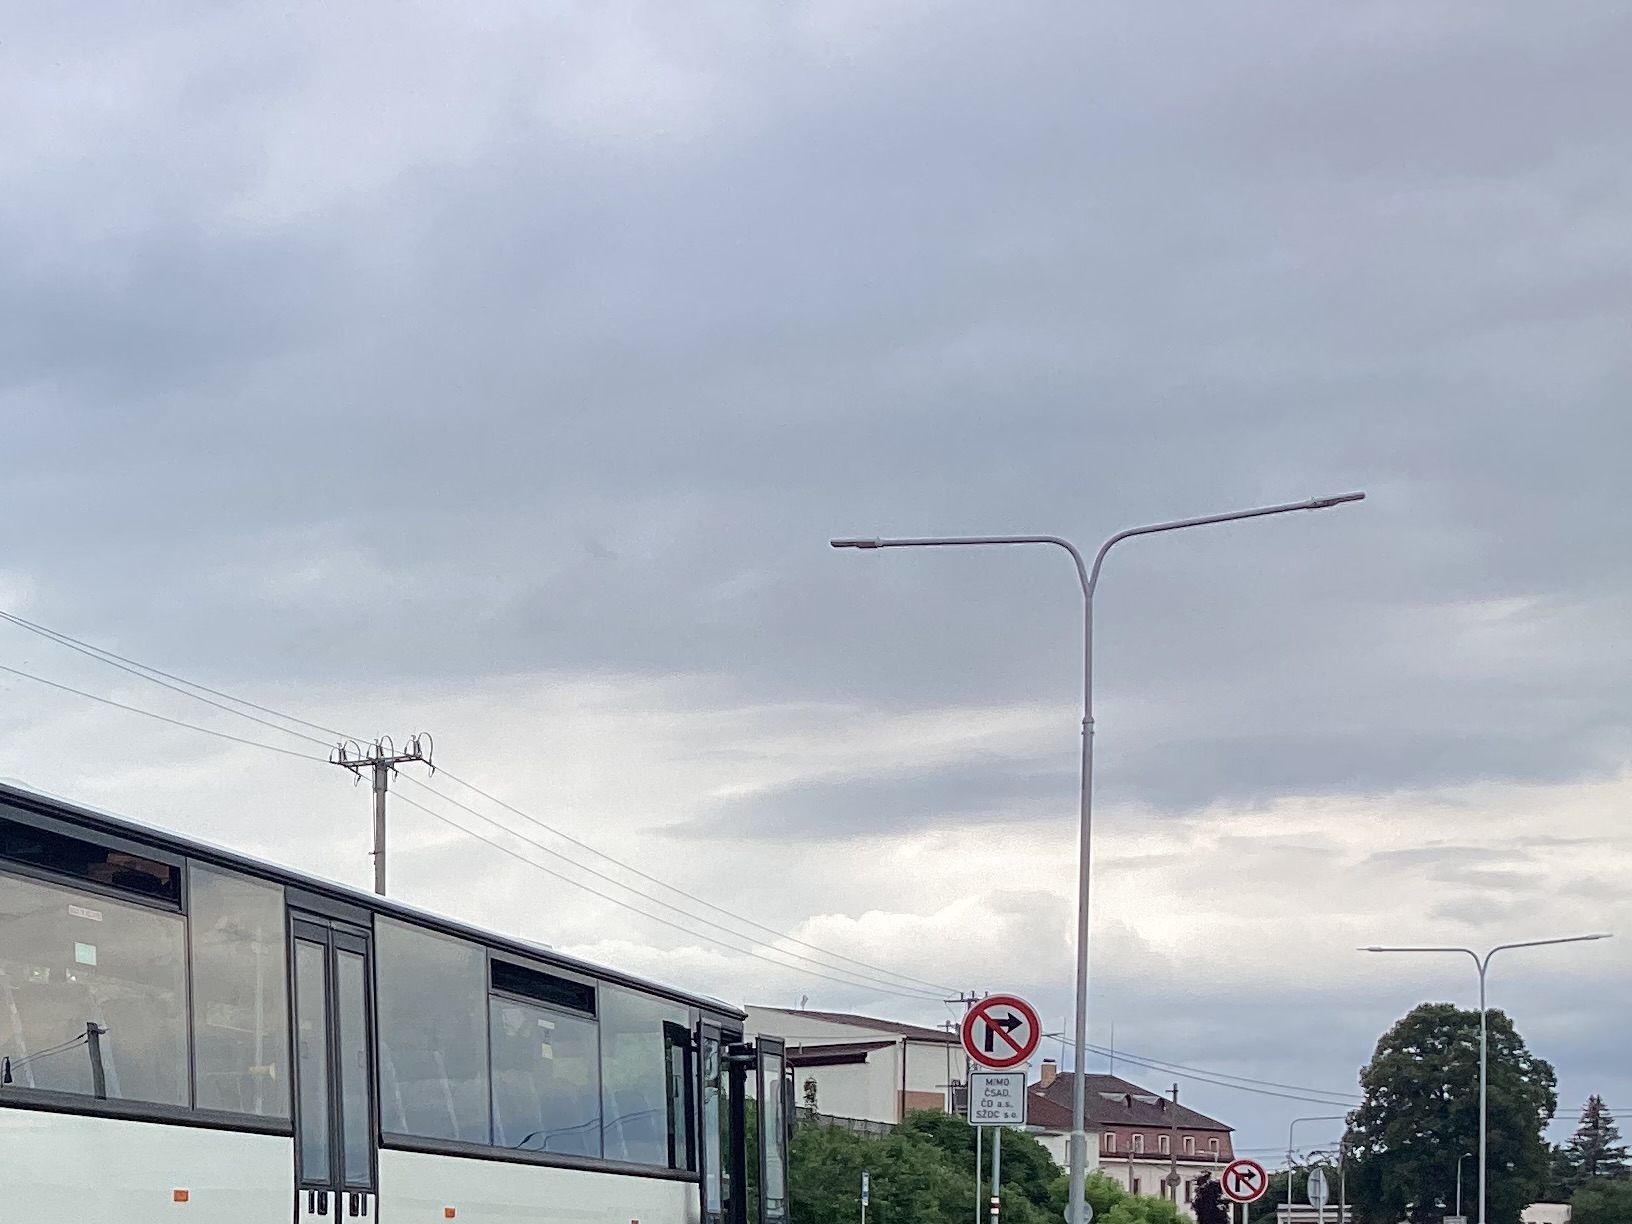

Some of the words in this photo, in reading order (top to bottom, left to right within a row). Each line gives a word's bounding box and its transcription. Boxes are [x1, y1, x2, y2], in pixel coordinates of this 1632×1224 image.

[985, 1078, 1010, 1087] MIMO
[980, 1098, 994, 1108] ČD
[976, 1109, 1000, 1119] SŽDC
